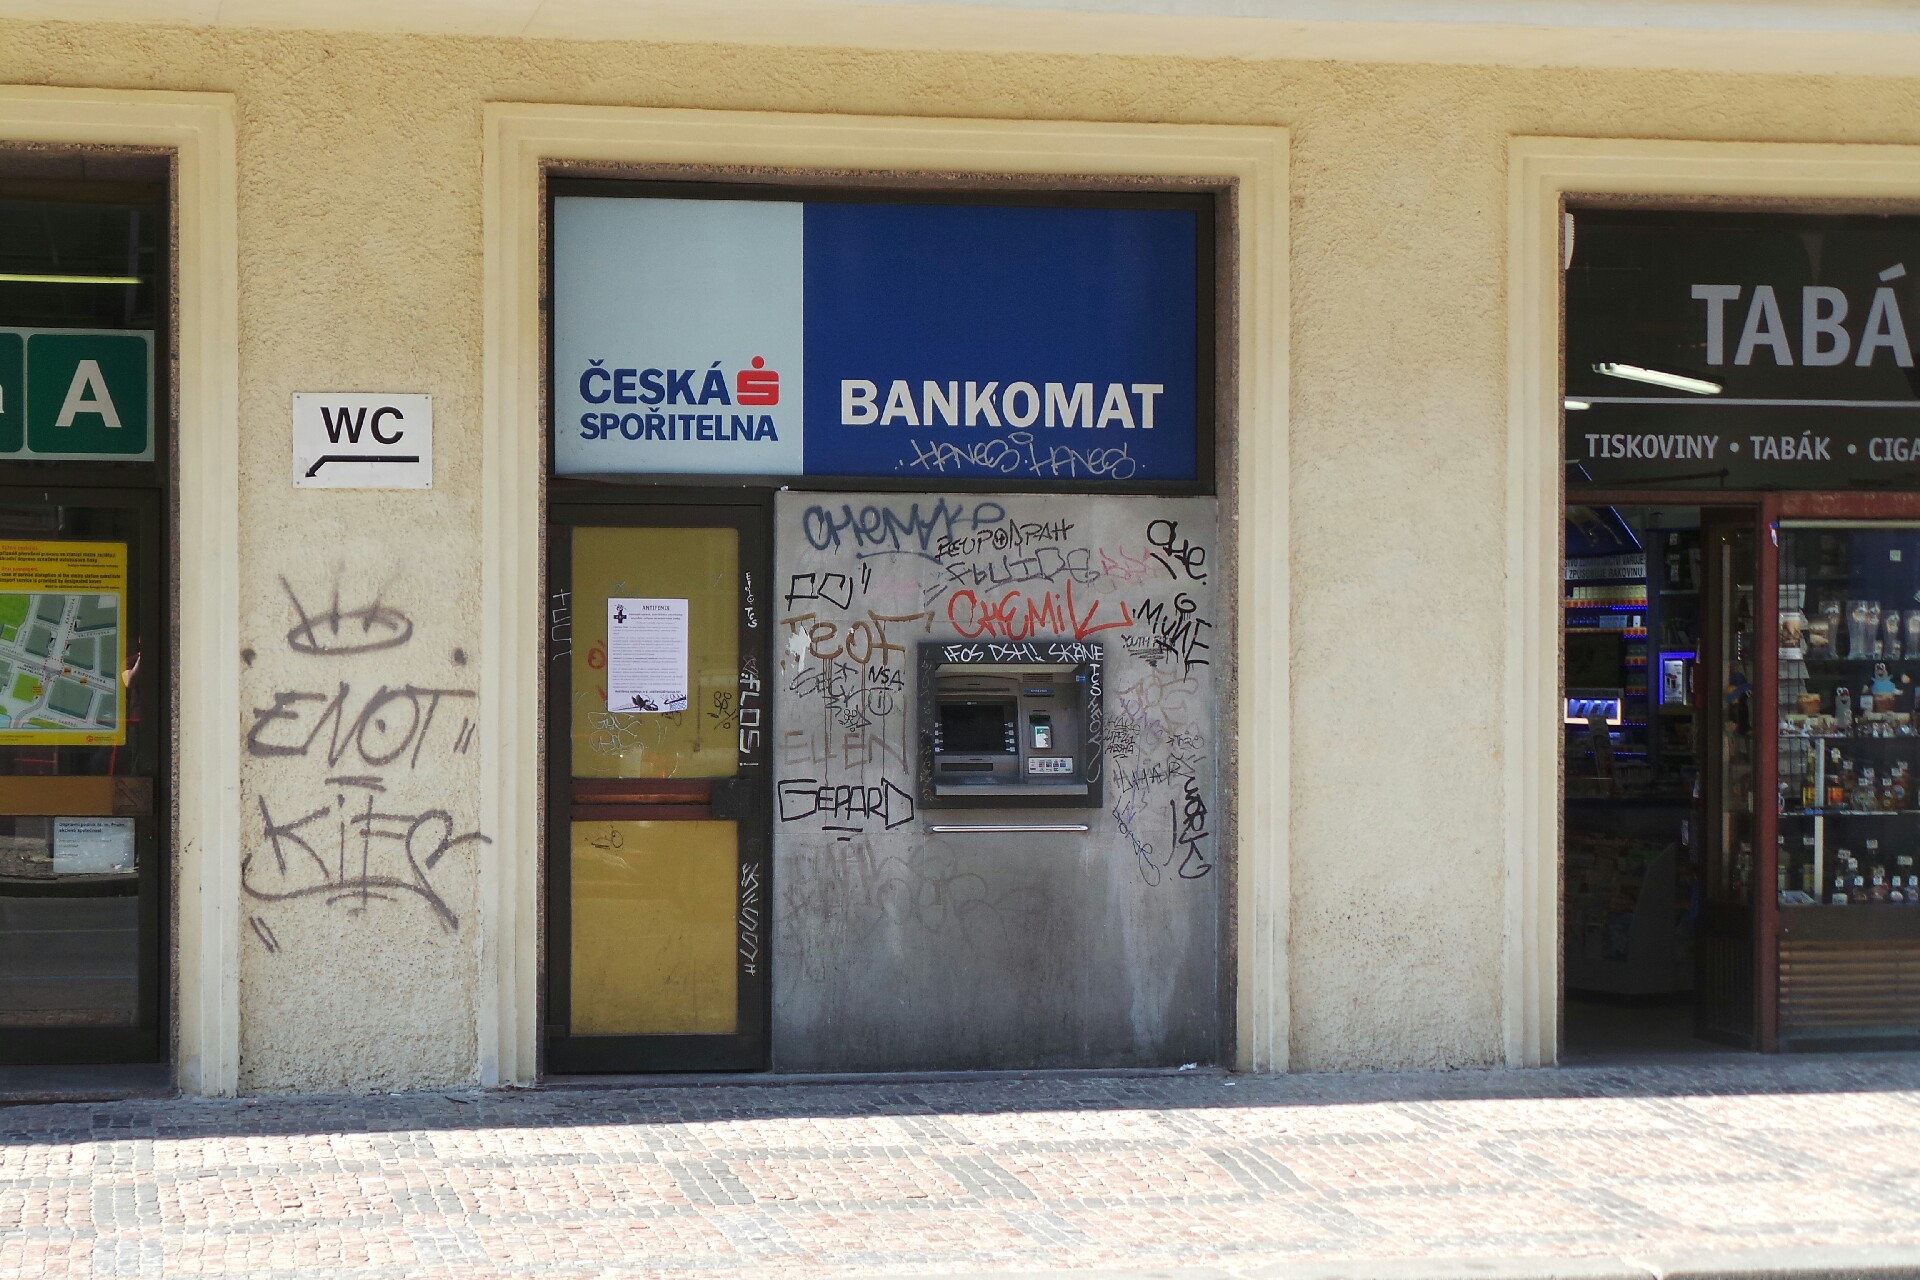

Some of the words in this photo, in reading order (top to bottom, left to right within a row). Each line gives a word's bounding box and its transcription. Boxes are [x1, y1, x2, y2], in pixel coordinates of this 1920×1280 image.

[55, 359, 122, 428] A
[579, 359, 731, 405] ČESKÁ
[579, 407, 779, 441] SPOŘITELNA
[841, 379, 1164, 429] BANKOMAT
[320, 406, 404, 445] WC
[1585, 433, 1719, 460] TISKOVINY
[1750, 429, 1831, 461] TABÁK
